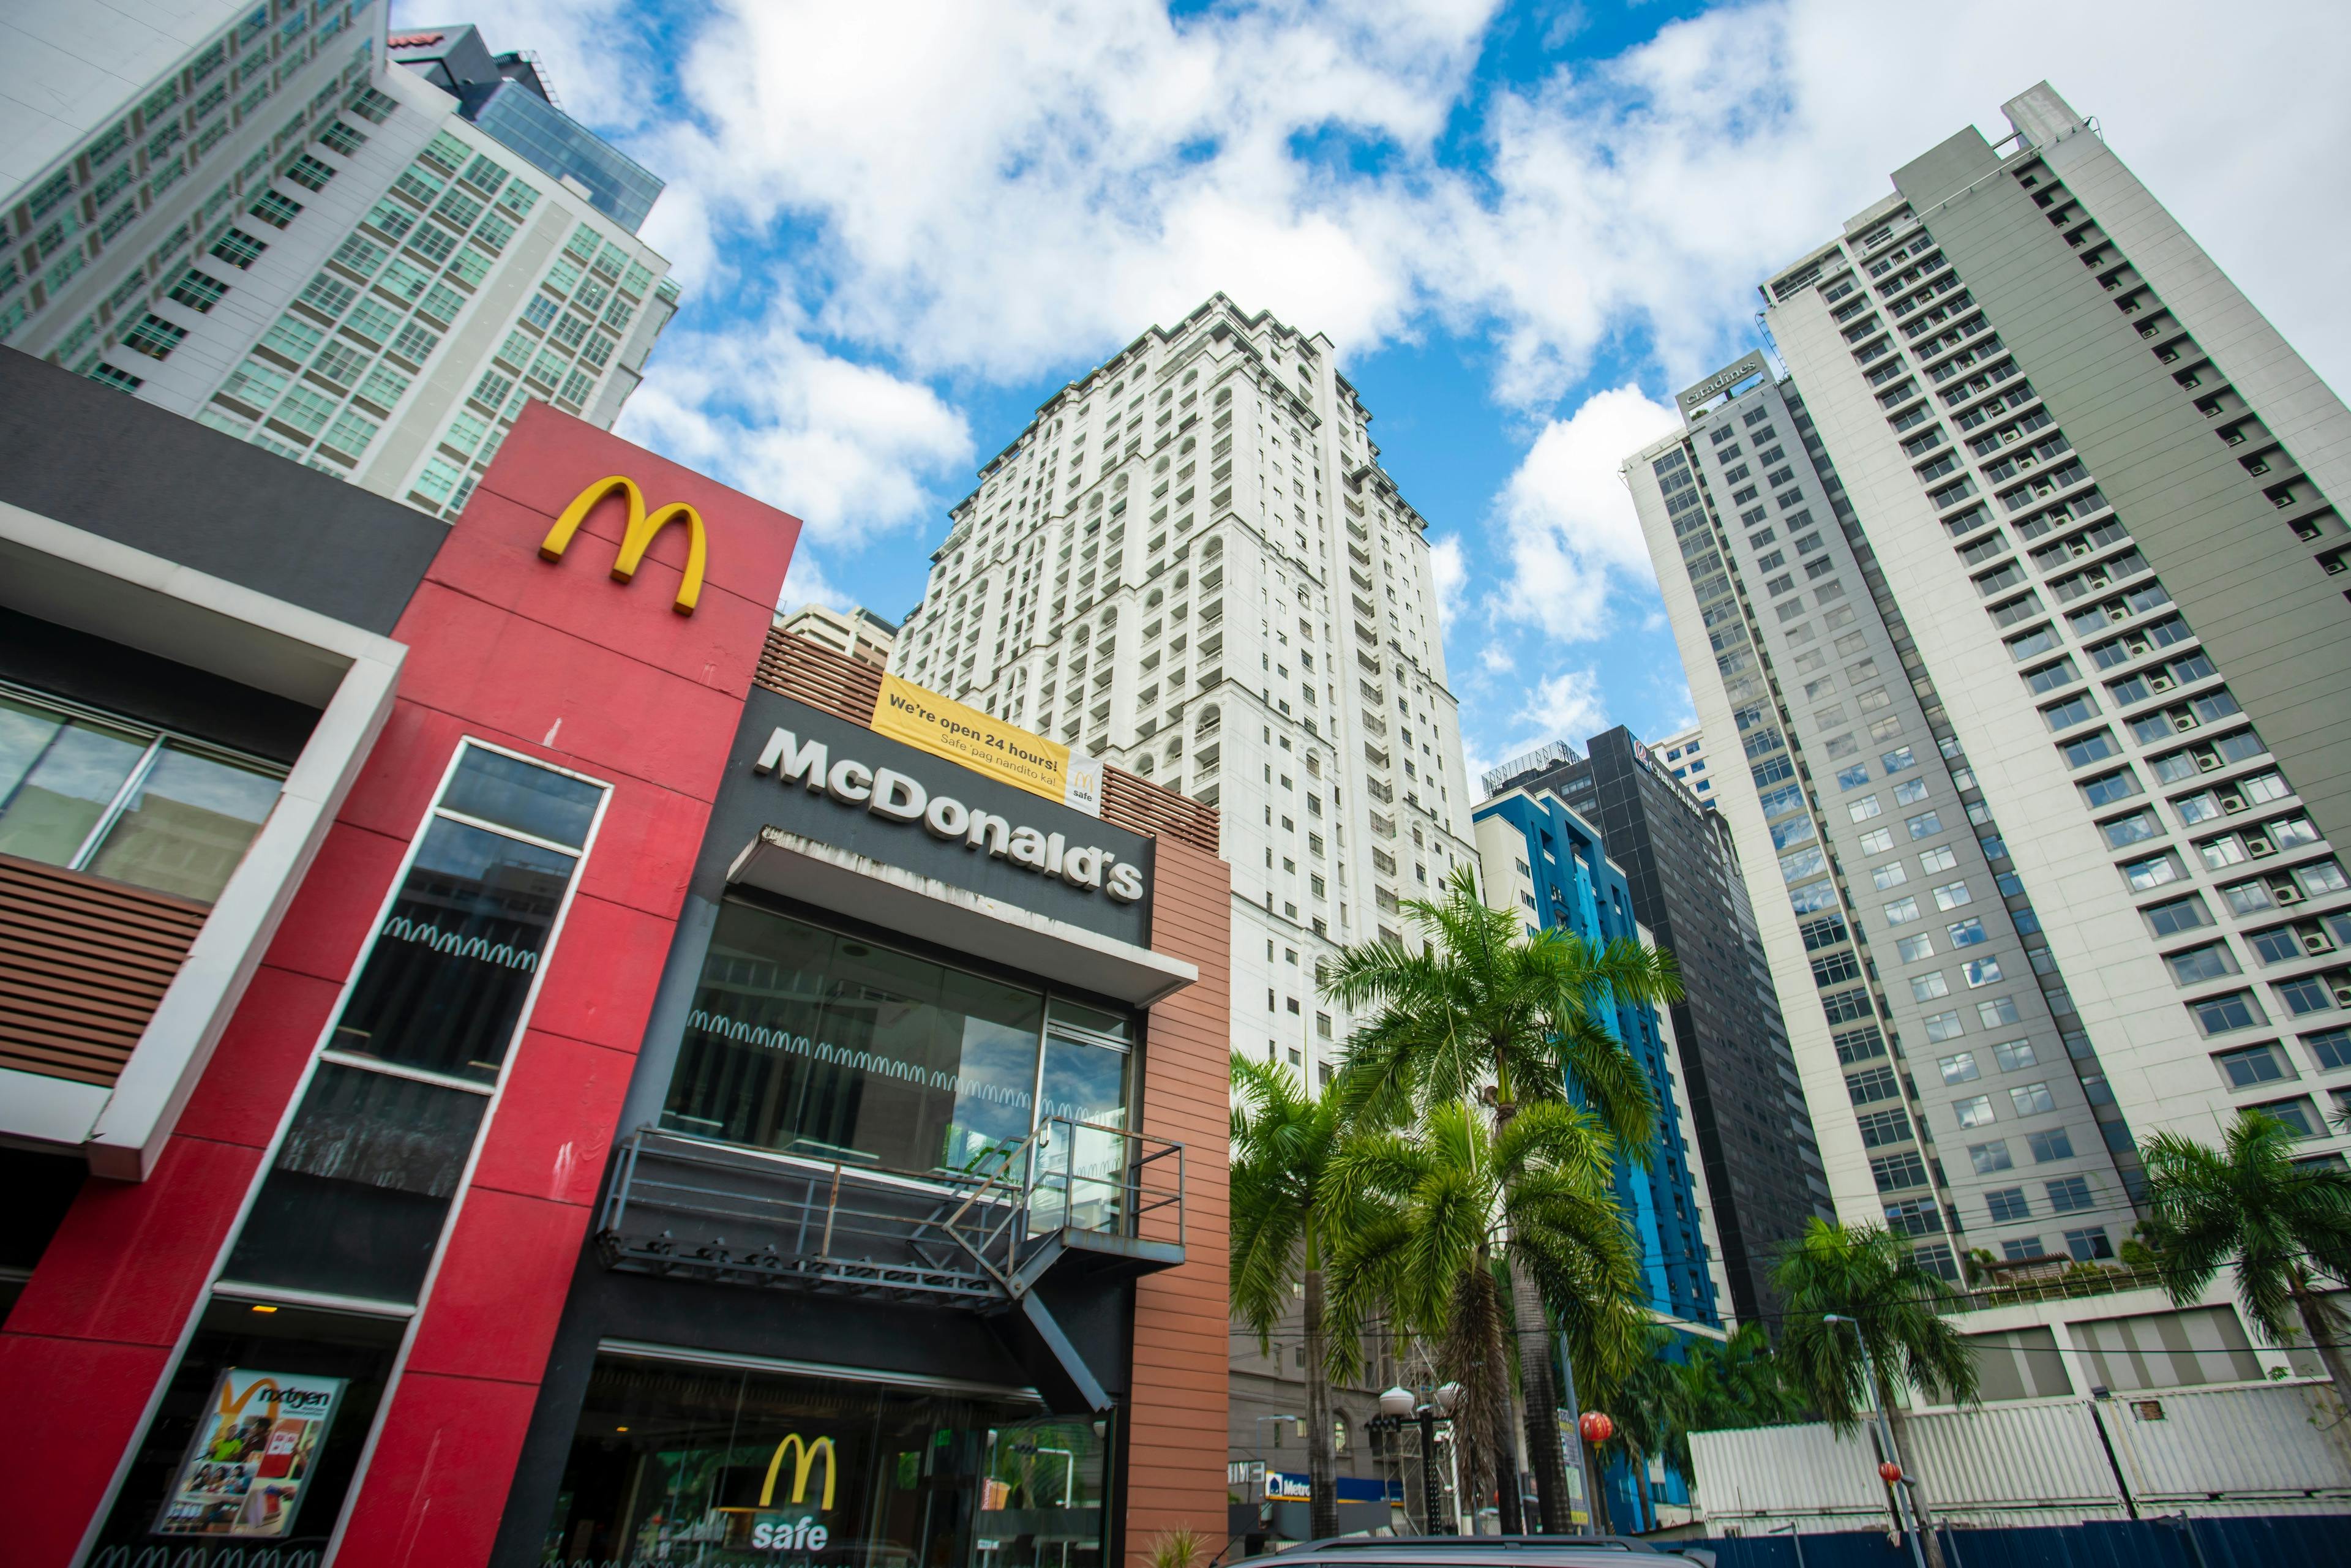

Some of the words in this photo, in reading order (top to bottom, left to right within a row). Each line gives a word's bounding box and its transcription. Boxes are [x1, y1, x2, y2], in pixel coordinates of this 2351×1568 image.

[1686, 359, 1757, 405] citadines
[890, 693, 936, 722] We're
[940, 718, 980, 741] open
[984, 734, 1005, 751] 24
[1008, 742, 1058, 772] hours!
[940, 733, 967, 751] Safe
[970, 745, 993, 763] 'pag
[996, 757, 1038, 779] nandito
[1040, 773, 1056, 787] ka!
[753, 726, 1144, 903] McDonald's
[1073, 790, 1093, 802] safe
[257, 1387, 331, 1409] nxtgen
[751, 1515, 829, 1551] safe
